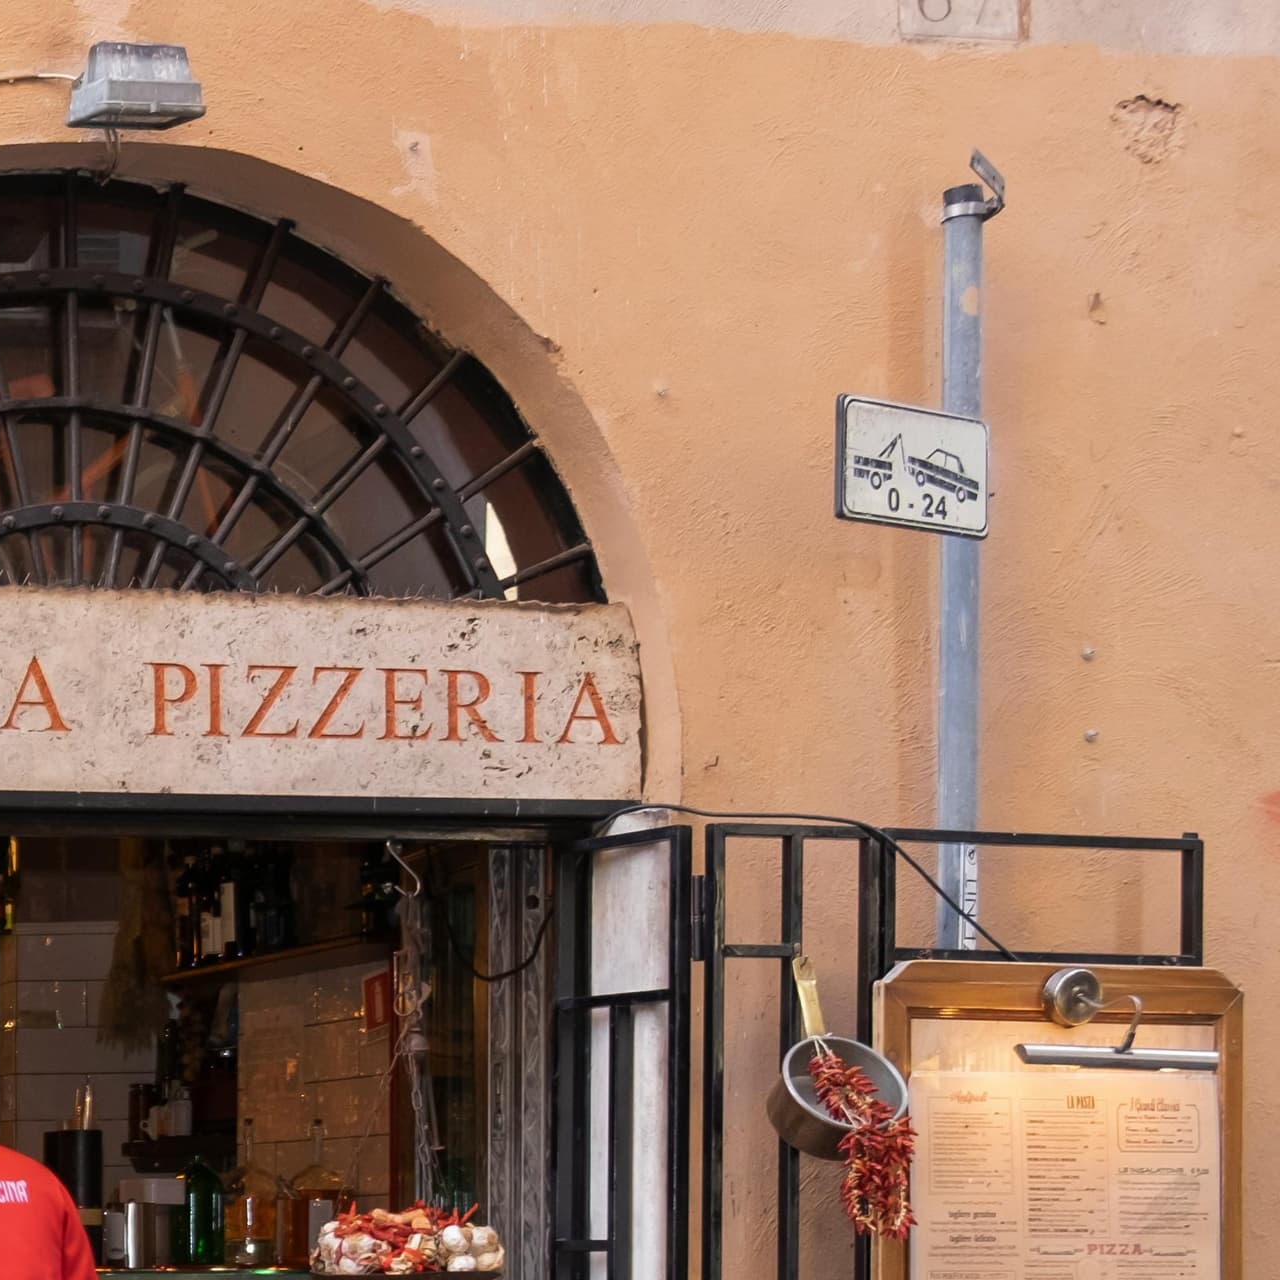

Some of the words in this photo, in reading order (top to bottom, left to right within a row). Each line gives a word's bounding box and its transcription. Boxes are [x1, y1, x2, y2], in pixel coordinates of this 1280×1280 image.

[887, 487, 902, 513] 0
[920, 494, 948, 521] 24
[142, 661, 625, 746] PIZZERIA
[1086, 1243, 1144, 1256] PIZZA
